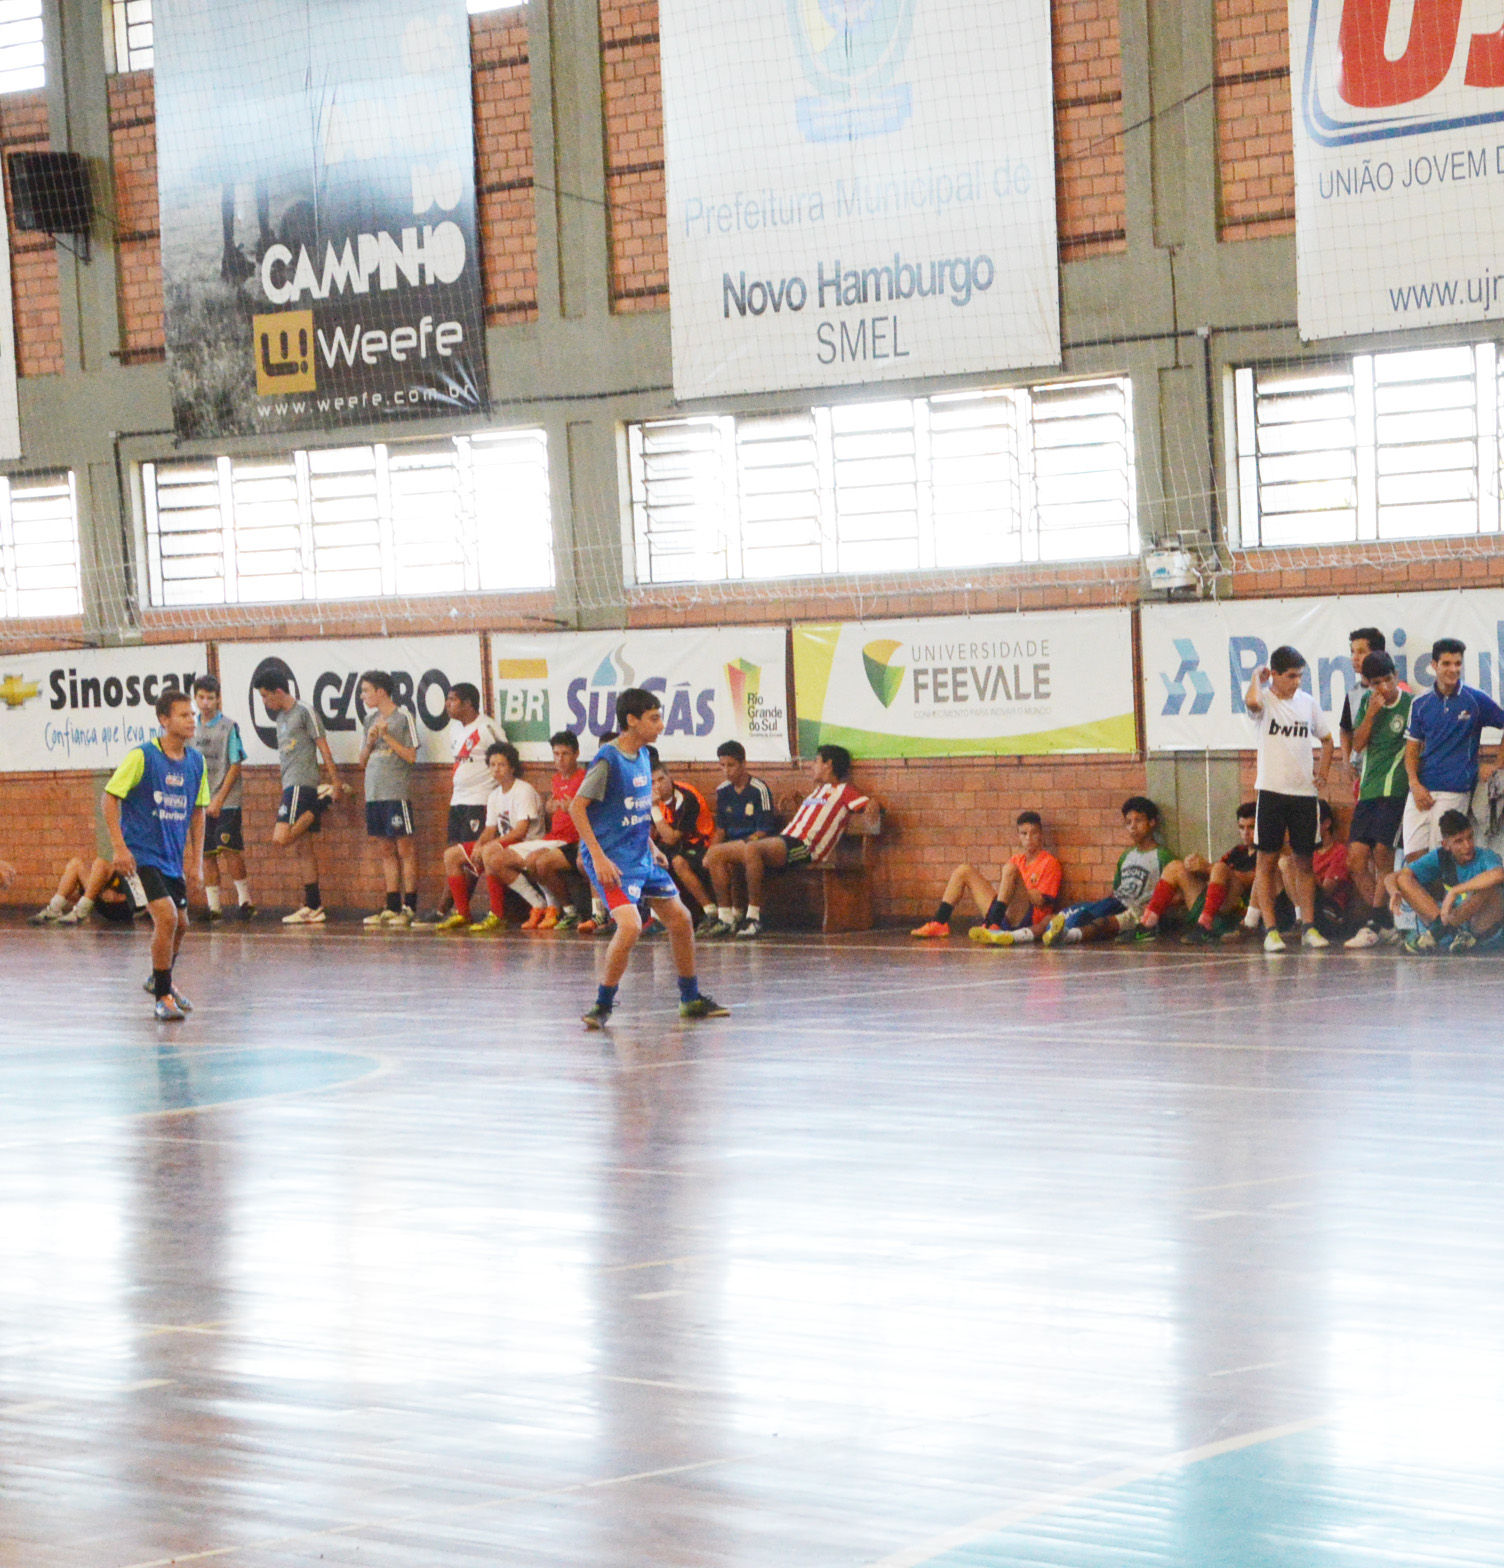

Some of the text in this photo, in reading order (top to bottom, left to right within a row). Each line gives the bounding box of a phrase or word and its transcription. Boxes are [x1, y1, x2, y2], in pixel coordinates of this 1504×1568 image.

[1319, 158, 1394, 199] UNIÃO
[1402, 148, 1487, 188] JOVEM
[684, 155, 1033, 238] Prefeitura Municipal de
[261, 221, 466, 304] CAMPINHO
[722, 251, 995, 319] Novo Hamburgo
[316, 315, 463, 369] Weefe
[816, 314, 911, 365] SMEL
[257, 382, 471, 417] www.weefe.combr
[911, 640, 1050, 662] UNIVERSIDADE
[747, 692, 764, 705] Rio
[913, 663, 1052, 704] FEEVALE
[505, 688, 545, 722] BR
[566, 676, 716, 737] SUÁS
[747, 705, 783, 718] Grande
[761, 719, 778, 732] Sul
[1268, 718, 1309, 738] bwin
